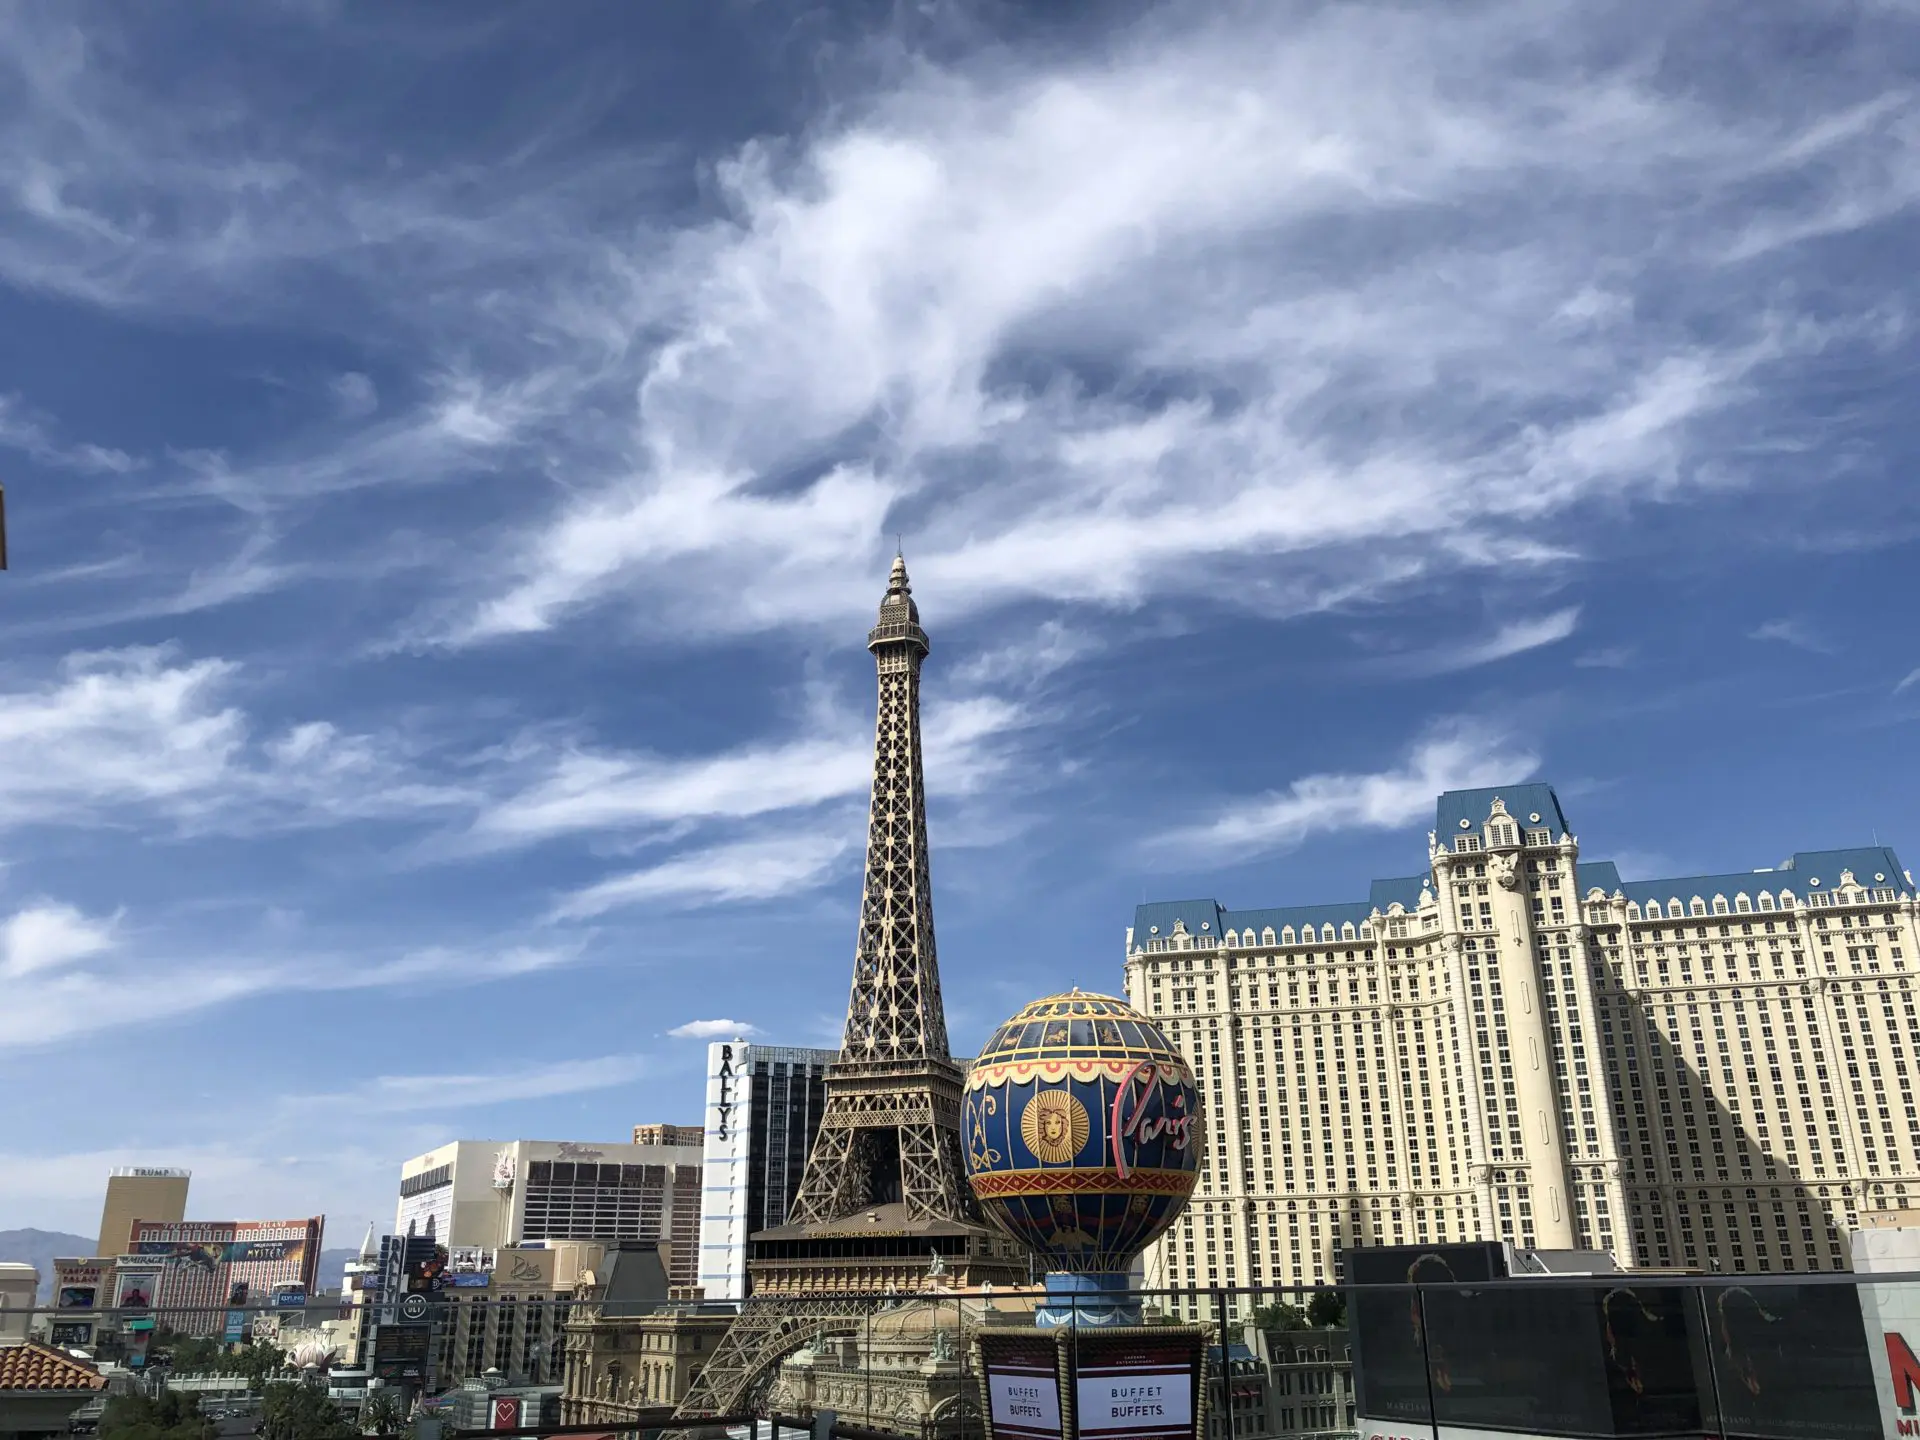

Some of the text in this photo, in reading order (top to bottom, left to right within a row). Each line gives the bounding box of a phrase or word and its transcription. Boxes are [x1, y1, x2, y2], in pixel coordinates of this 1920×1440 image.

[1111, 1060, 1198, 1180] Paris
[134, 1168, 170, 1177] TRUMP
[257, 1221, 287, 1229] ISLAND
[812, 1229, 905, 1239] EIFFEL TOWER RESTAURANT
[1008, 1386, 1039, 1398] BUFFET
[1111, 1386, 1163, 1398] BUFFET
[1111, 1404, 1165, 1418] BUFFETS.
